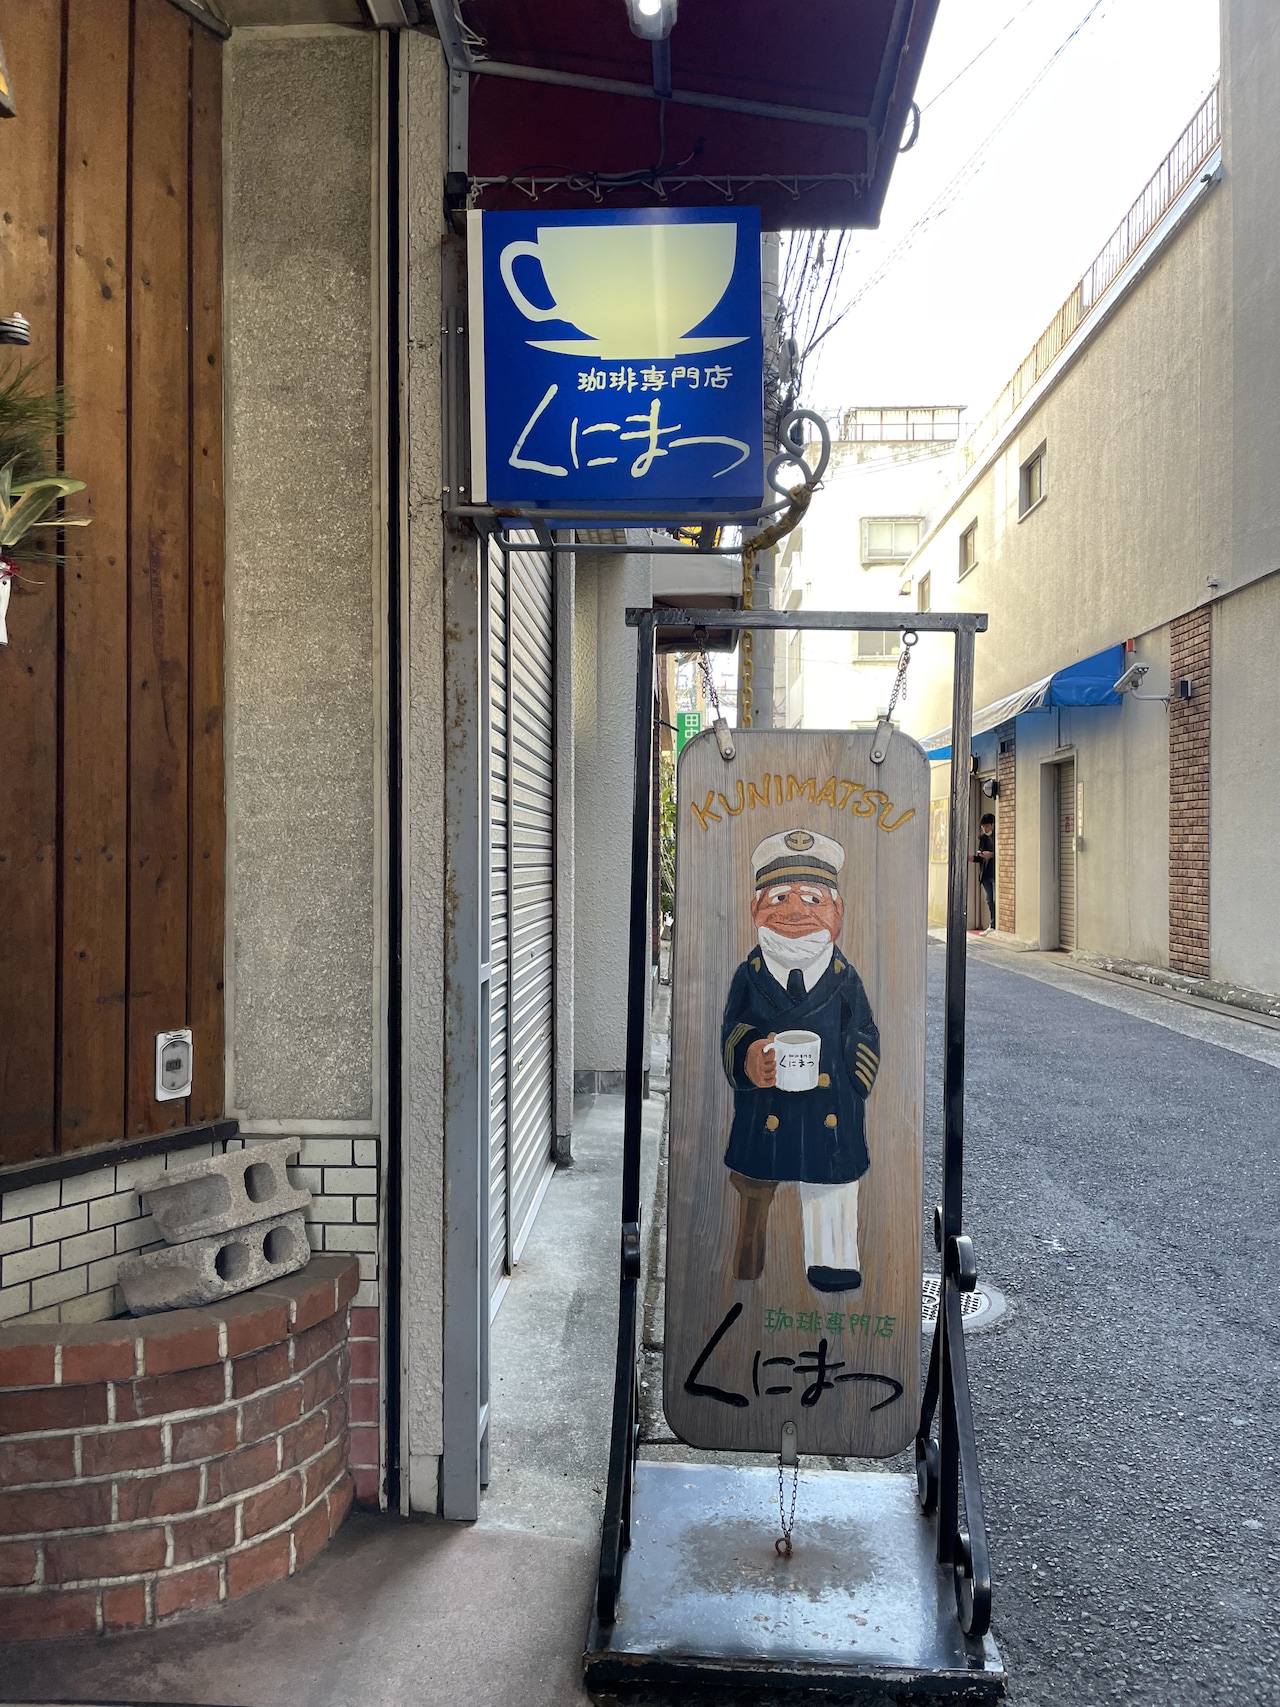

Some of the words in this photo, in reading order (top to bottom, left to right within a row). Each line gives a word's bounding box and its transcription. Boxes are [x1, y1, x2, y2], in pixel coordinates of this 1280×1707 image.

[577, 365, 733, 393] 珈琲専門店
[509, 384, 750, 478] くにまつ
[690, 773, 916, 832] KUNIMATSU
[763, 1306, 897, 1338] 珈琲専門店
[683, 1301, 904, 1412] くにまつ
